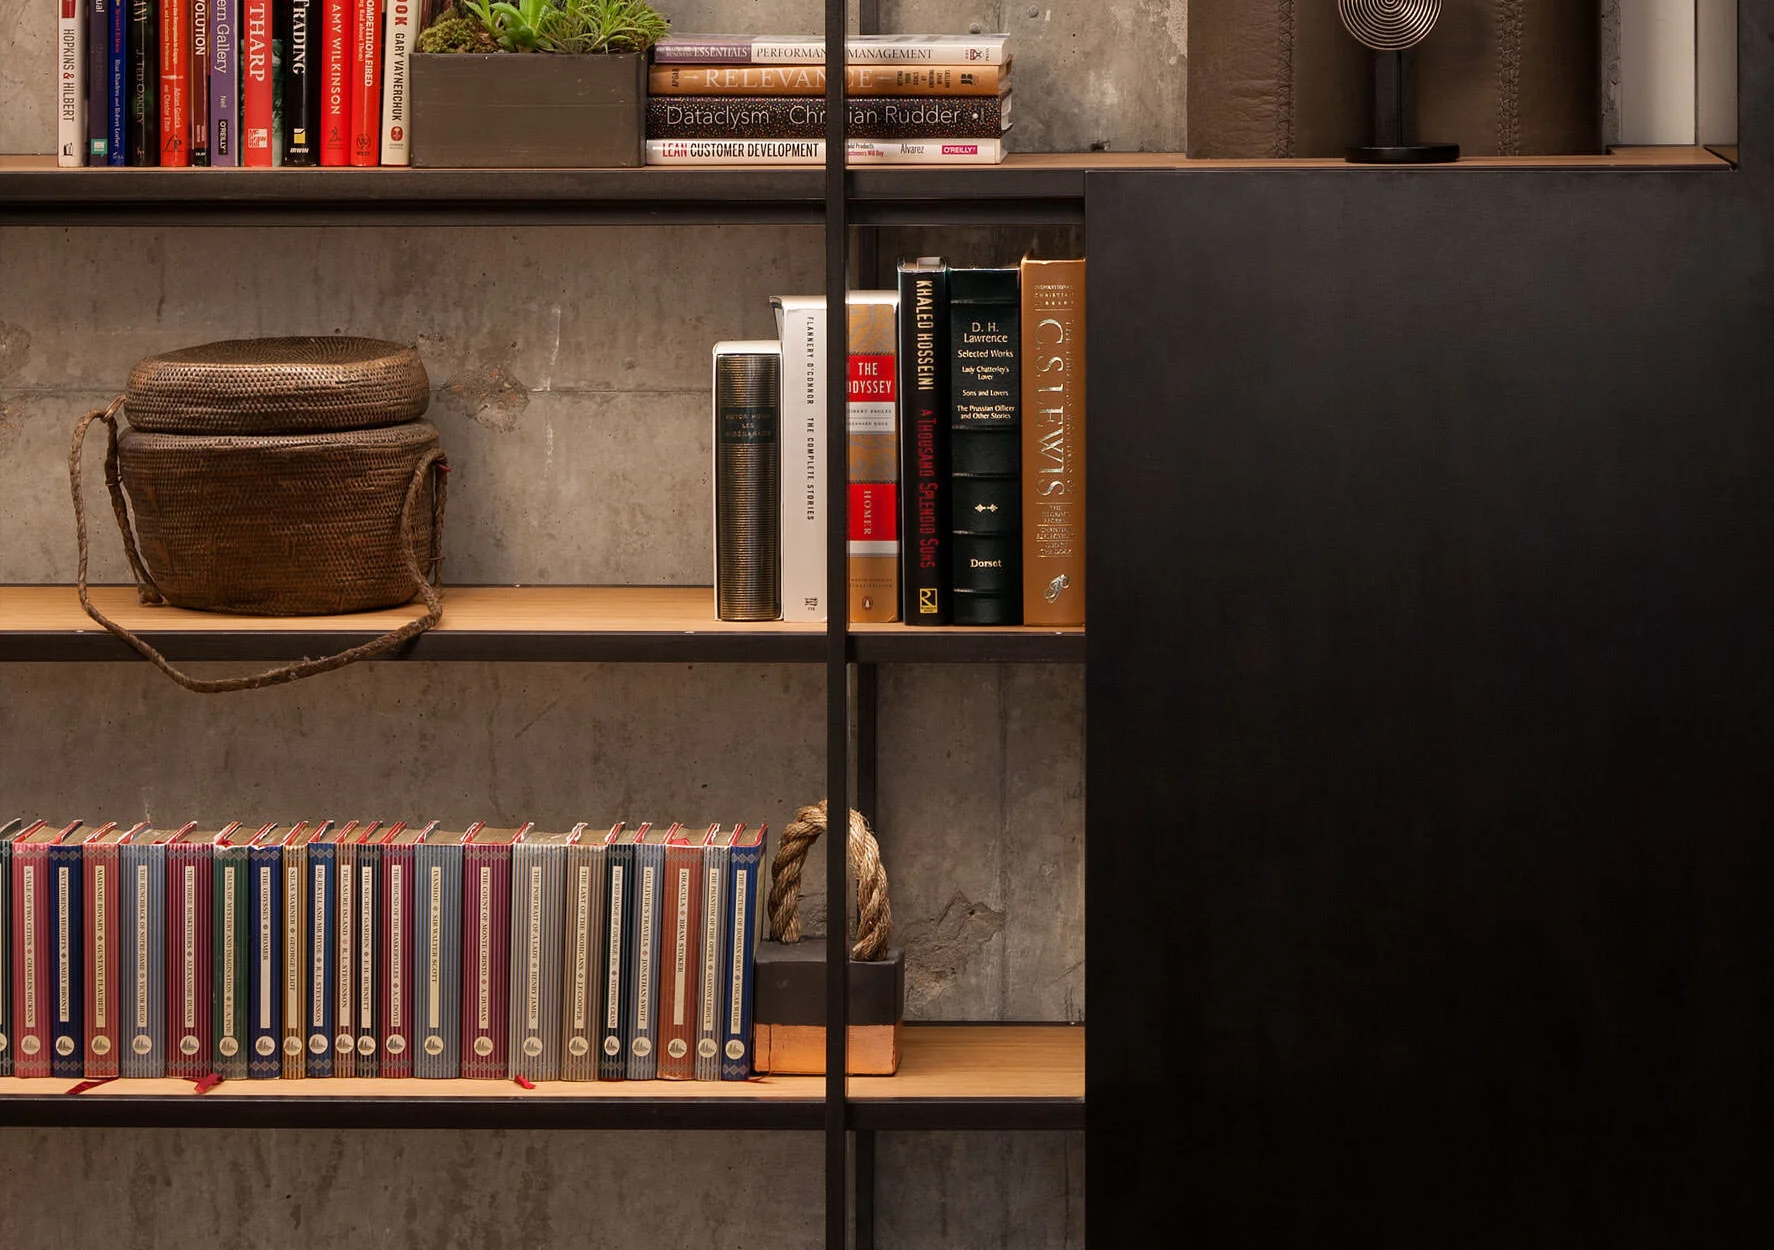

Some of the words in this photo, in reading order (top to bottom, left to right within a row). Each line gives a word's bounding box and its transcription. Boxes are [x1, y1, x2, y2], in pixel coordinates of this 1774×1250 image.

[331, 4, 342, 34] AMY
[63, 29, 75, 70] HOPKINS
[214, 25, 230, 74] Gallery
[250, 4, 266, 82] THARP
[395, 33, 405, 58] GARY
[63, 72, 74, 80] &
[330, 37, 342, 115] WILKINSON
[365, 60, 374, 87] FIRED
[392, 60, 404, 121] VAYNERCHUK
[63, 82, 74, 122] HILBERT
[667, 105, 770, 129] Dataclysm
[884, 106, 960, 124] Rudder
[662, 143, 687, 157] LEAN
[690, 143, 745, 157] CUSTOMER
[747, 143, 819, 157] DEVELOPMENT
[900, 143, 924, 154] Alvarez
[916, 280, 933, 328] KHALED
[806, 316, 814, 358] FLANNERY
[964, 333, 1008, 343] Lawrence
[972, 322, 984, 332] D.
[987, 322, 999, 332] H.
[858, 362, 878, 376] THE
[916, 333, 934, 390] HOSSEINI
[957, 350, 988, 358] Selected
[991, 350, 1014, 358] Works
[806, 363, 814, 405] O'CONNOR
[806, 418, 814, 432] THE
[806, 438, 814, 480] COMPLETE
[918, 418, 936, 477] THOUSAND
[806, 484, 814, 520] STORIES
[864, 490, 872, 534] HOMER
[919, 482, 938, 535] SPLENDID
[920, 538, 939, 568] SUNS
[970, 558, 1002, 568] Dorset
[679, 871, 687, 907] DRACULA
[641, 959, 649, 998] JONATHAN
